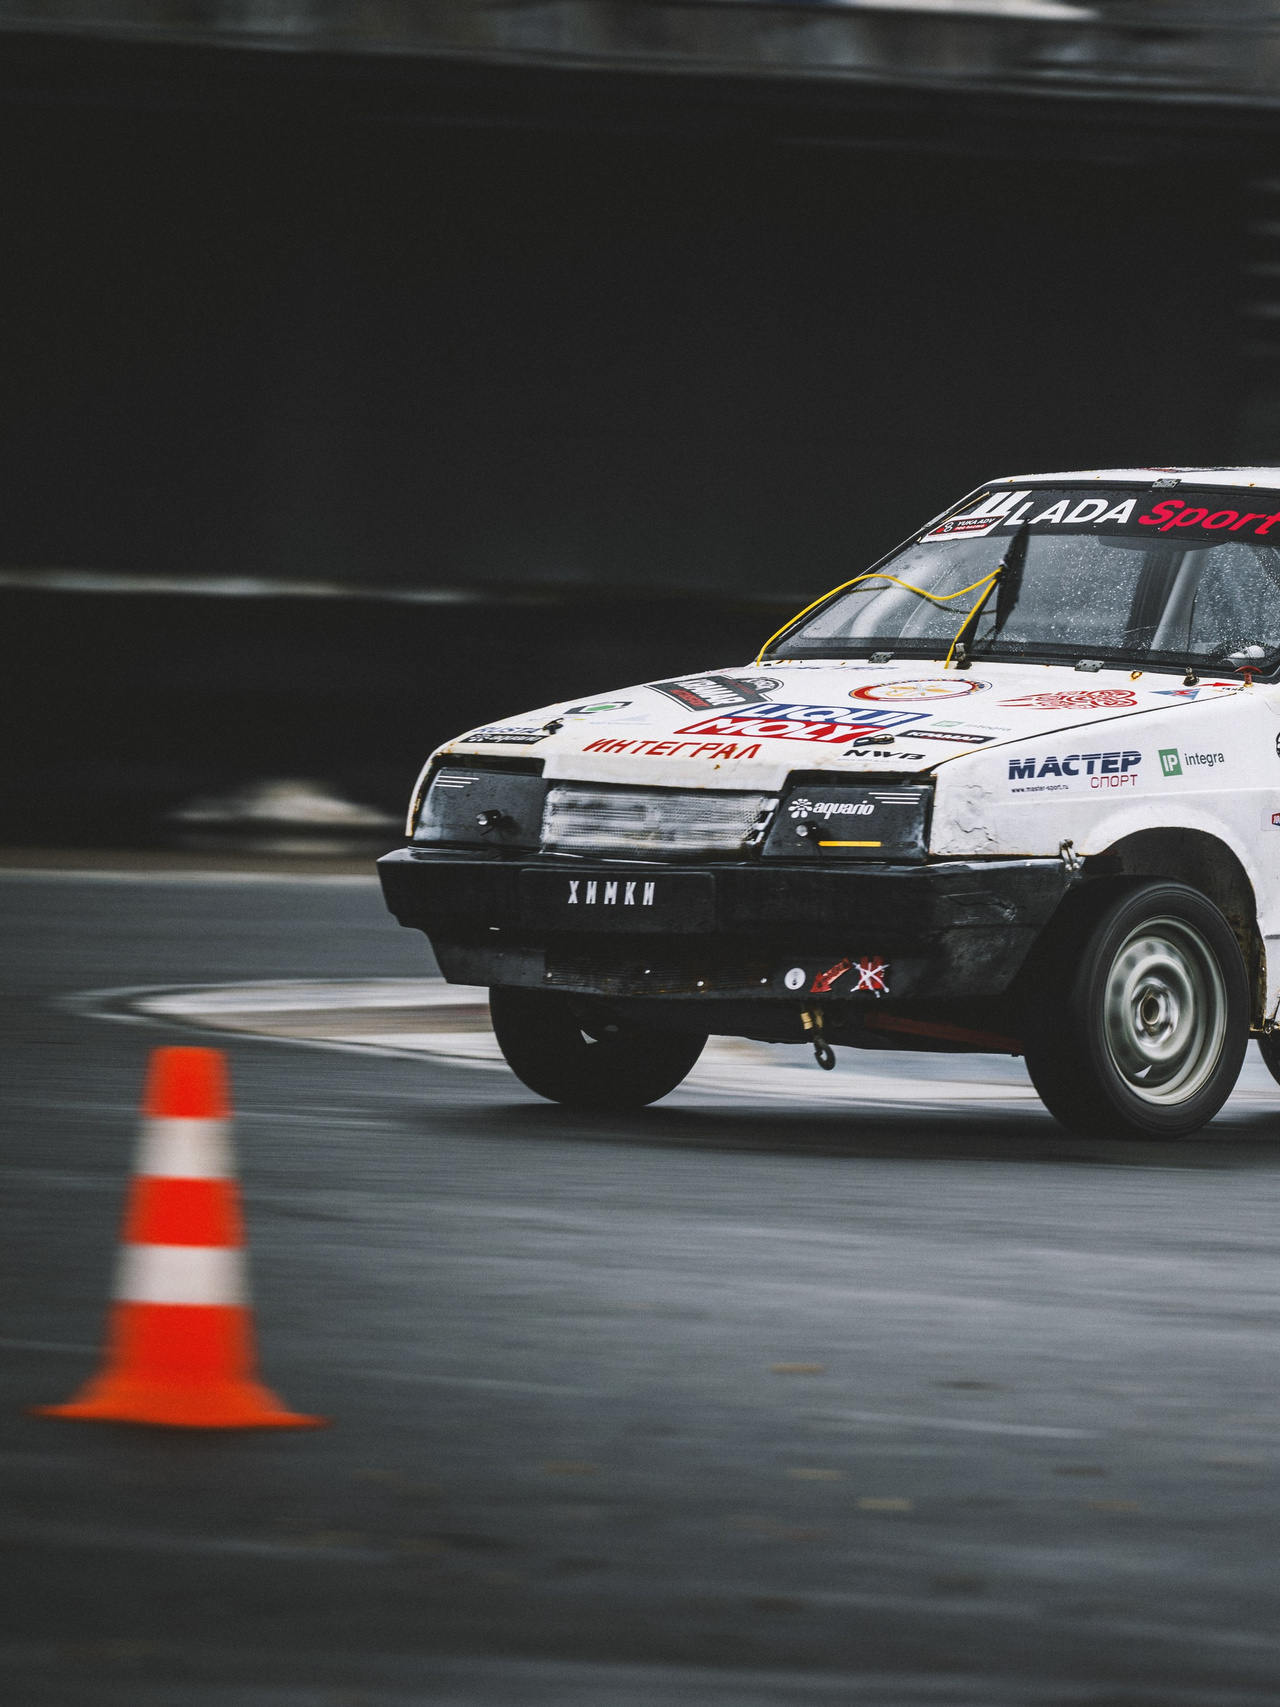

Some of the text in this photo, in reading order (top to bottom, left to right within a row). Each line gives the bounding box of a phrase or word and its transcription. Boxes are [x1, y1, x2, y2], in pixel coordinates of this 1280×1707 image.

[1003, 499, 1138, 527] LADA
[739, 704, 917, 726] LIQUI
[683, 717, 883, 742] MOLY
[581, 738, 763, 760] ИНТЕГРАЛ
[842, 749, 926, 760] NWB
[1008, 750, 1143, 780] МАСТЕР
[1162, 751, 1225, 773] IP integra
[1090, 774, 1138, 790] СПОРТ
[812, 799, 875, 820] aquario
[567, 878, 655, 906] ХИМКИ
